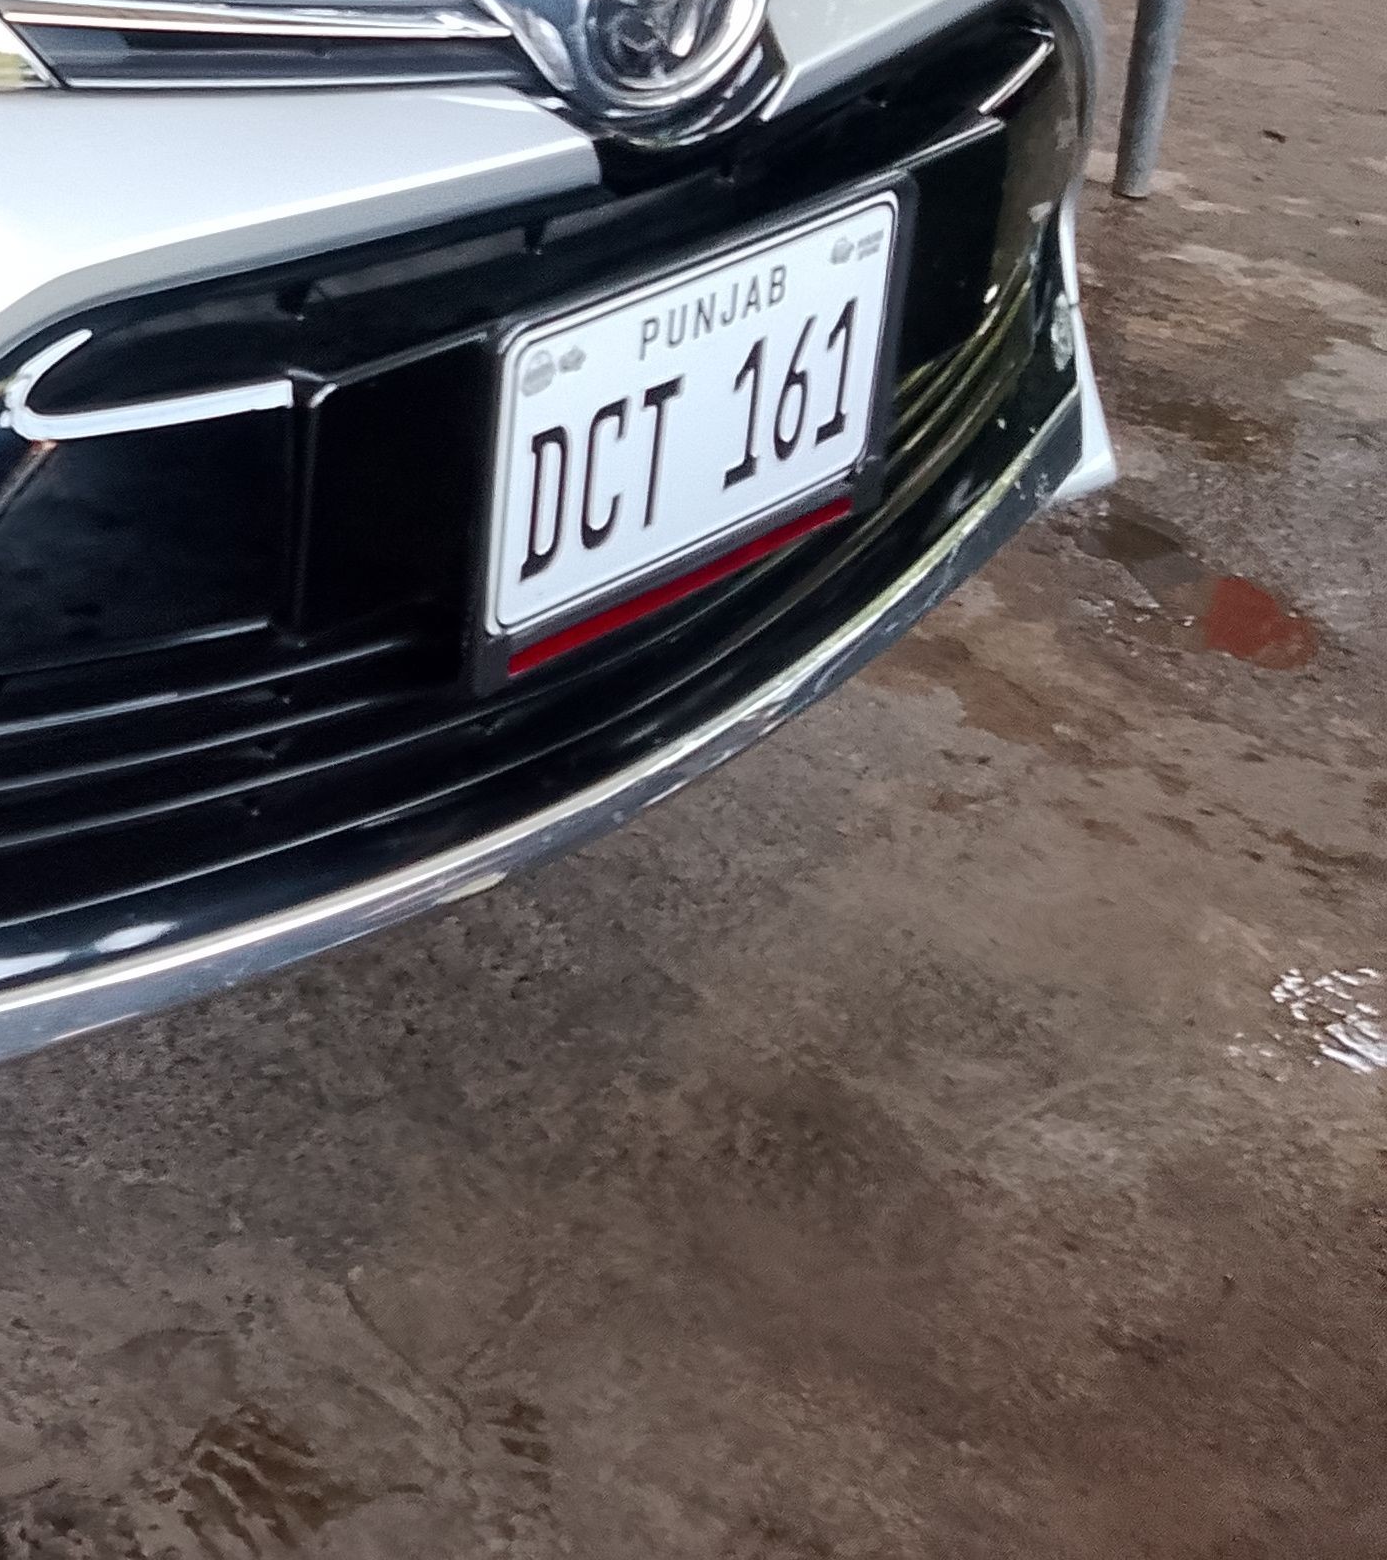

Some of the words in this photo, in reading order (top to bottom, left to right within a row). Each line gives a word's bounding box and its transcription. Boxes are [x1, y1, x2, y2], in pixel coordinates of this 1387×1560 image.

[638, 264, 789, 361] PUNJAB
[519, 375, 684, 582] DCT
[723, 296, 859, 490] 161
